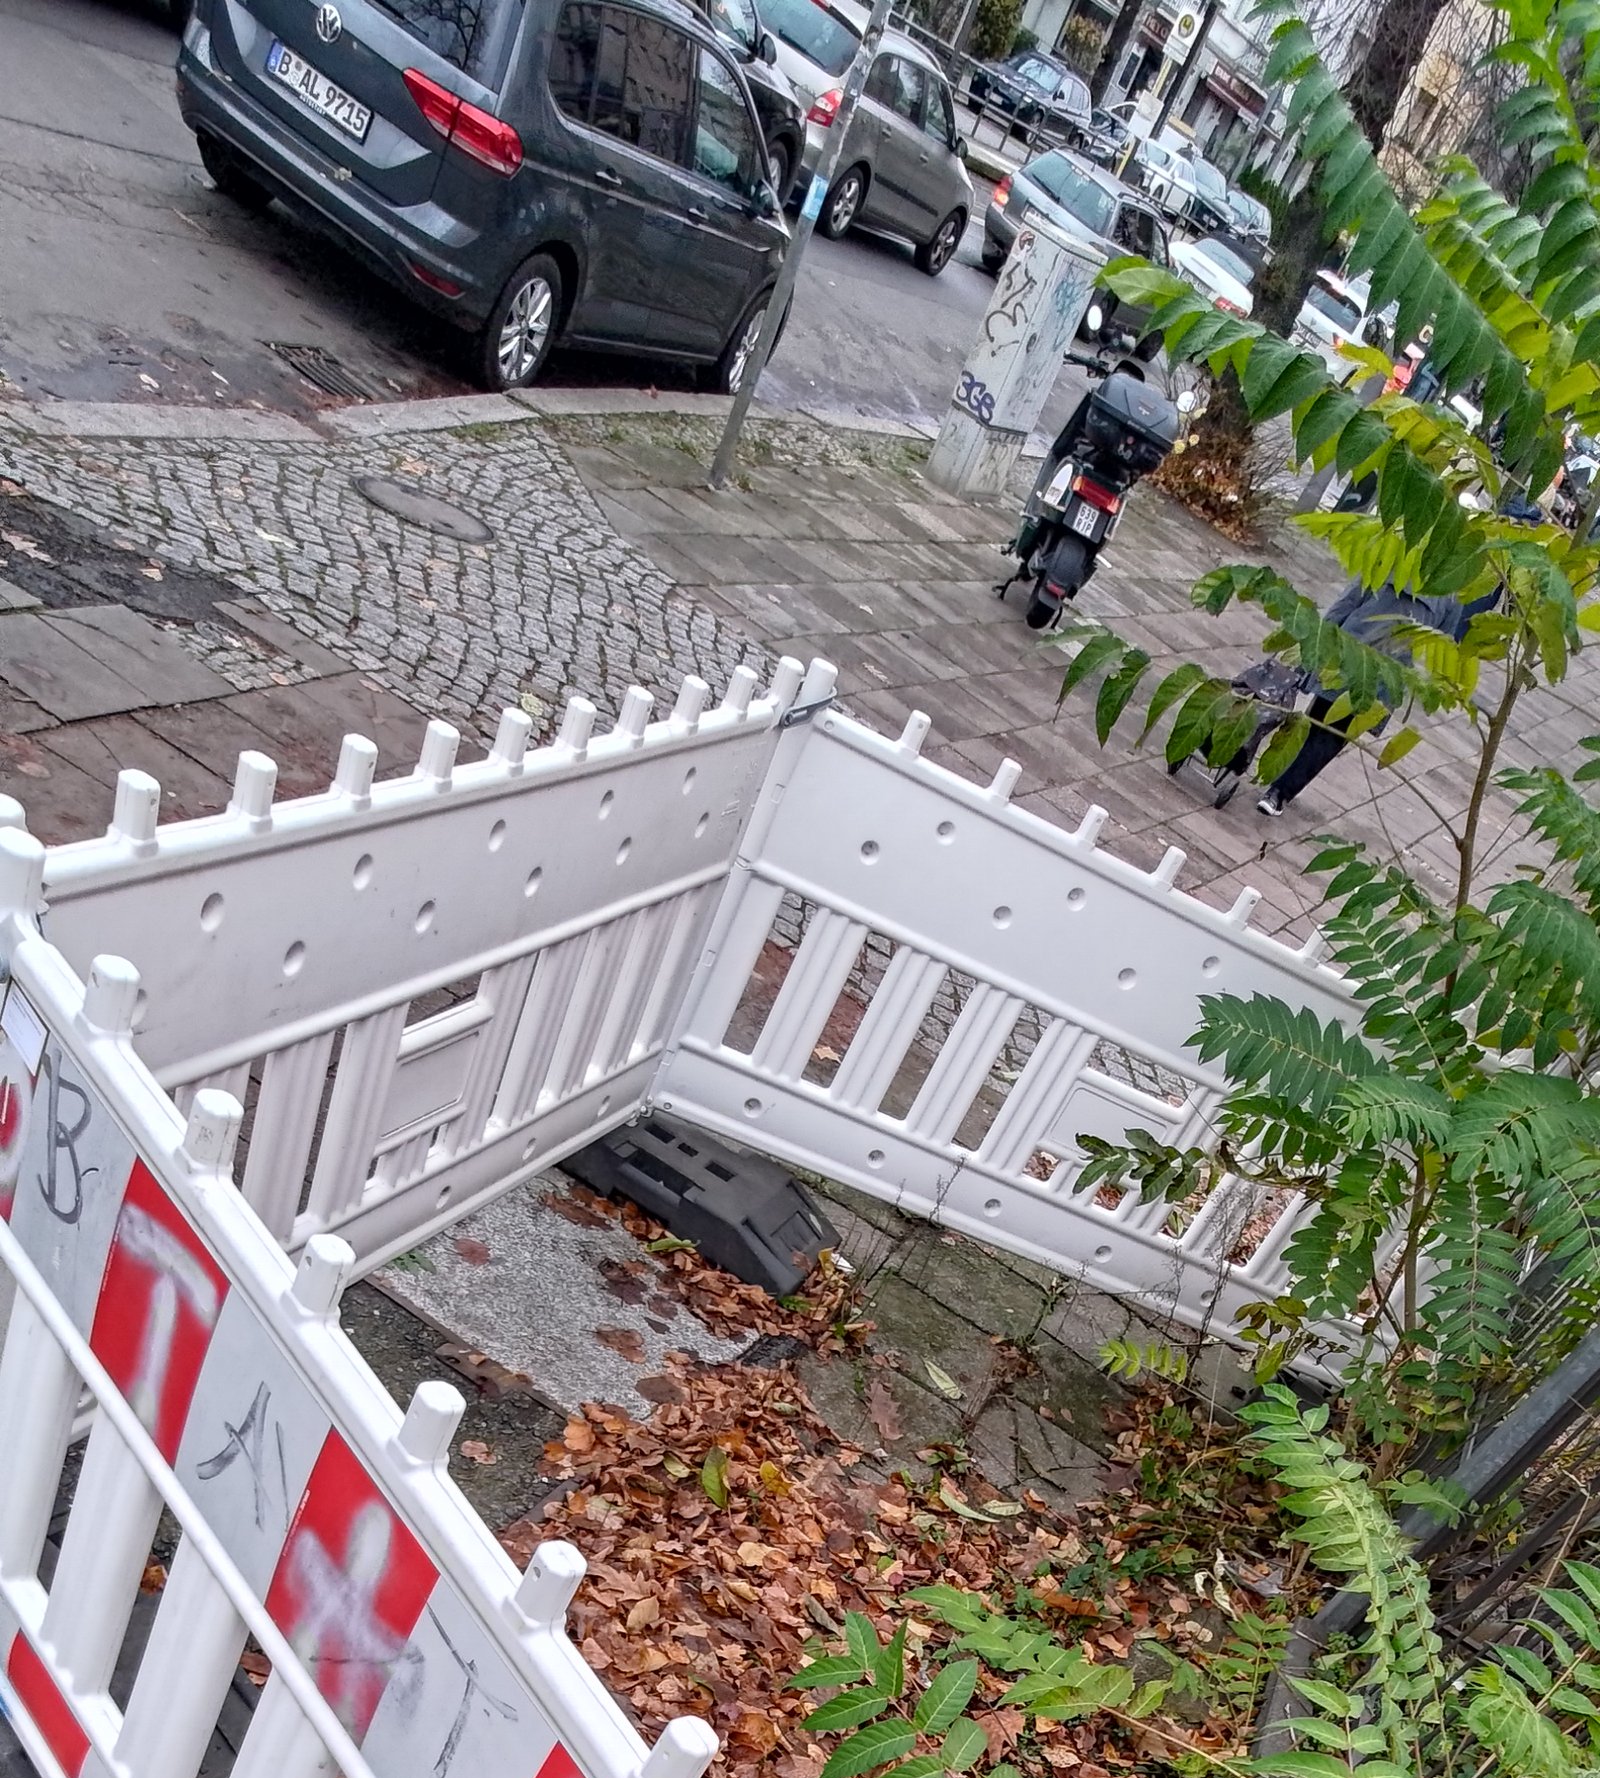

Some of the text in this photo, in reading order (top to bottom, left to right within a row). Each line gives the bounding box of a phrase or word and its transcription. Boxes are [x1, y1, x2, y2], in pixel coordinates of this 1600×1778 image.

[279, 51, 292, 76] B
[299, 69, 320, 100] AL
[324, 86, 368, 132] 9715
[1080, 506, 1097, 523] 639
